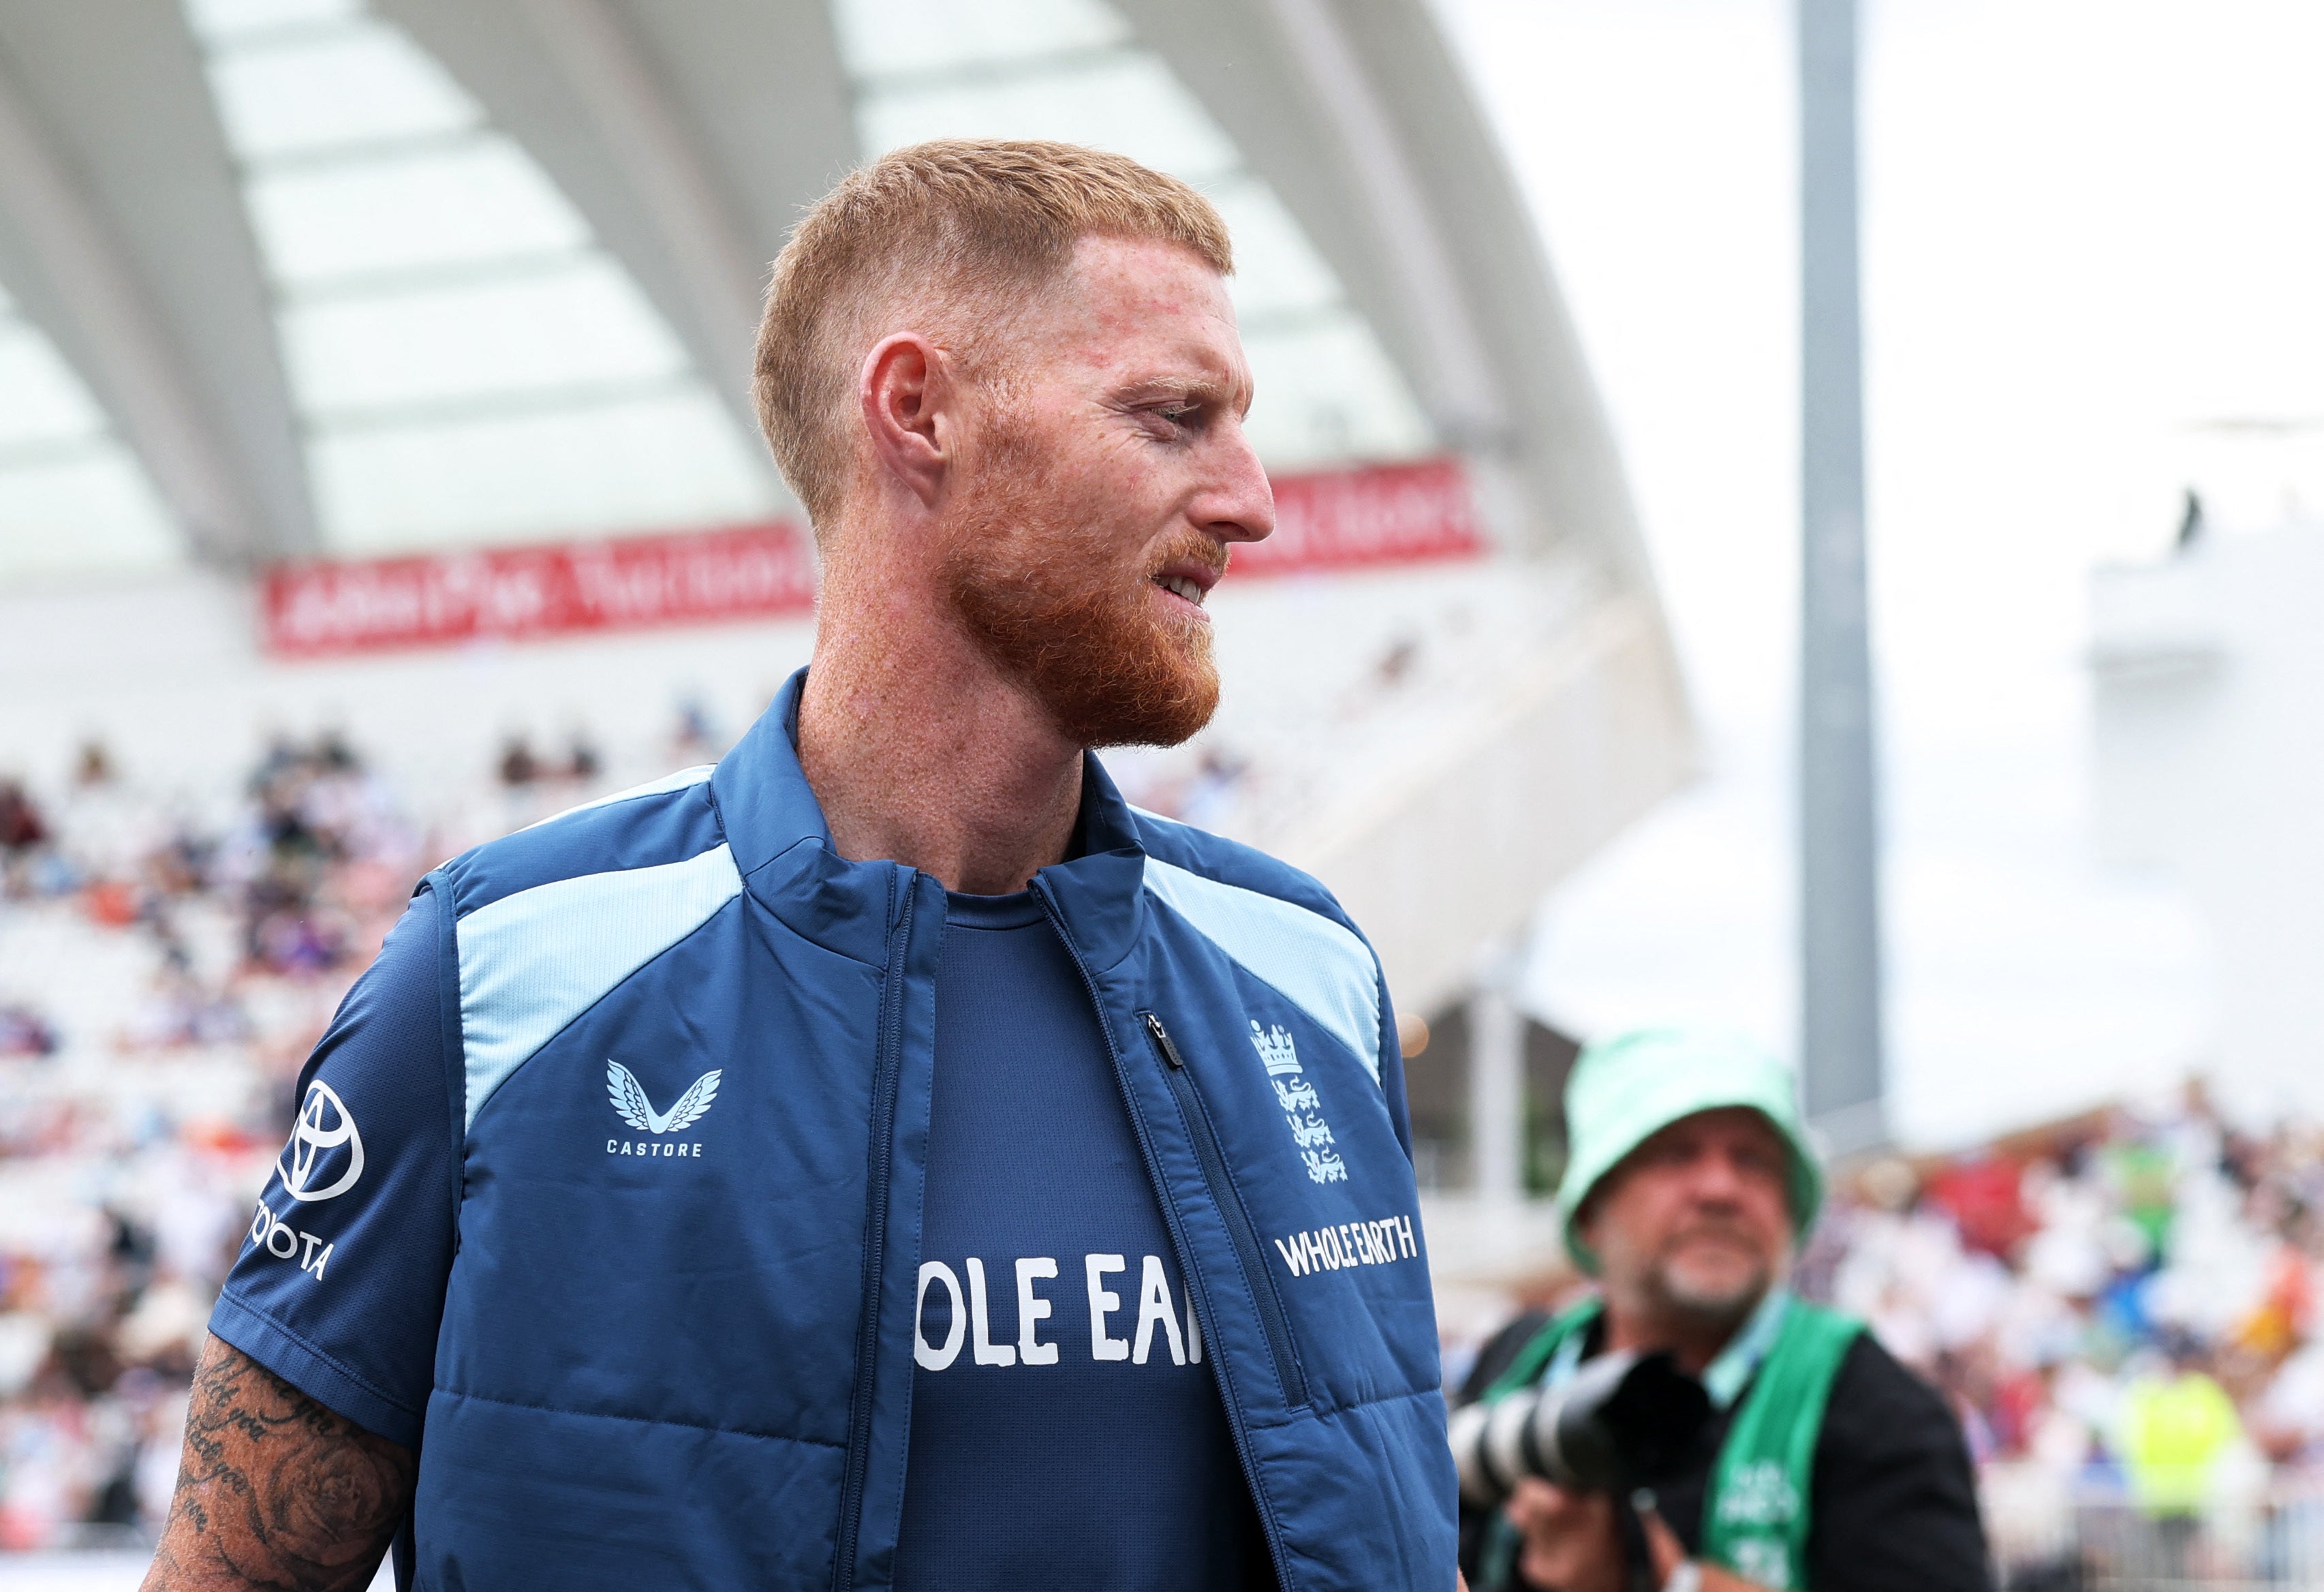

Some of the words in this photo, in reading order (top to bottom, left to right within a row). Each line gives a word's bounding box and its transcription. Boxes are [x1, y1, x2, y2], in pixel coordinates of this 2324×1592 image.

[606, 1139, 702, 1157] CASTORE
[1274, 1225, 1359, 1277] WHOLE
[1350, 1215, 1417, 1266] EARTH
